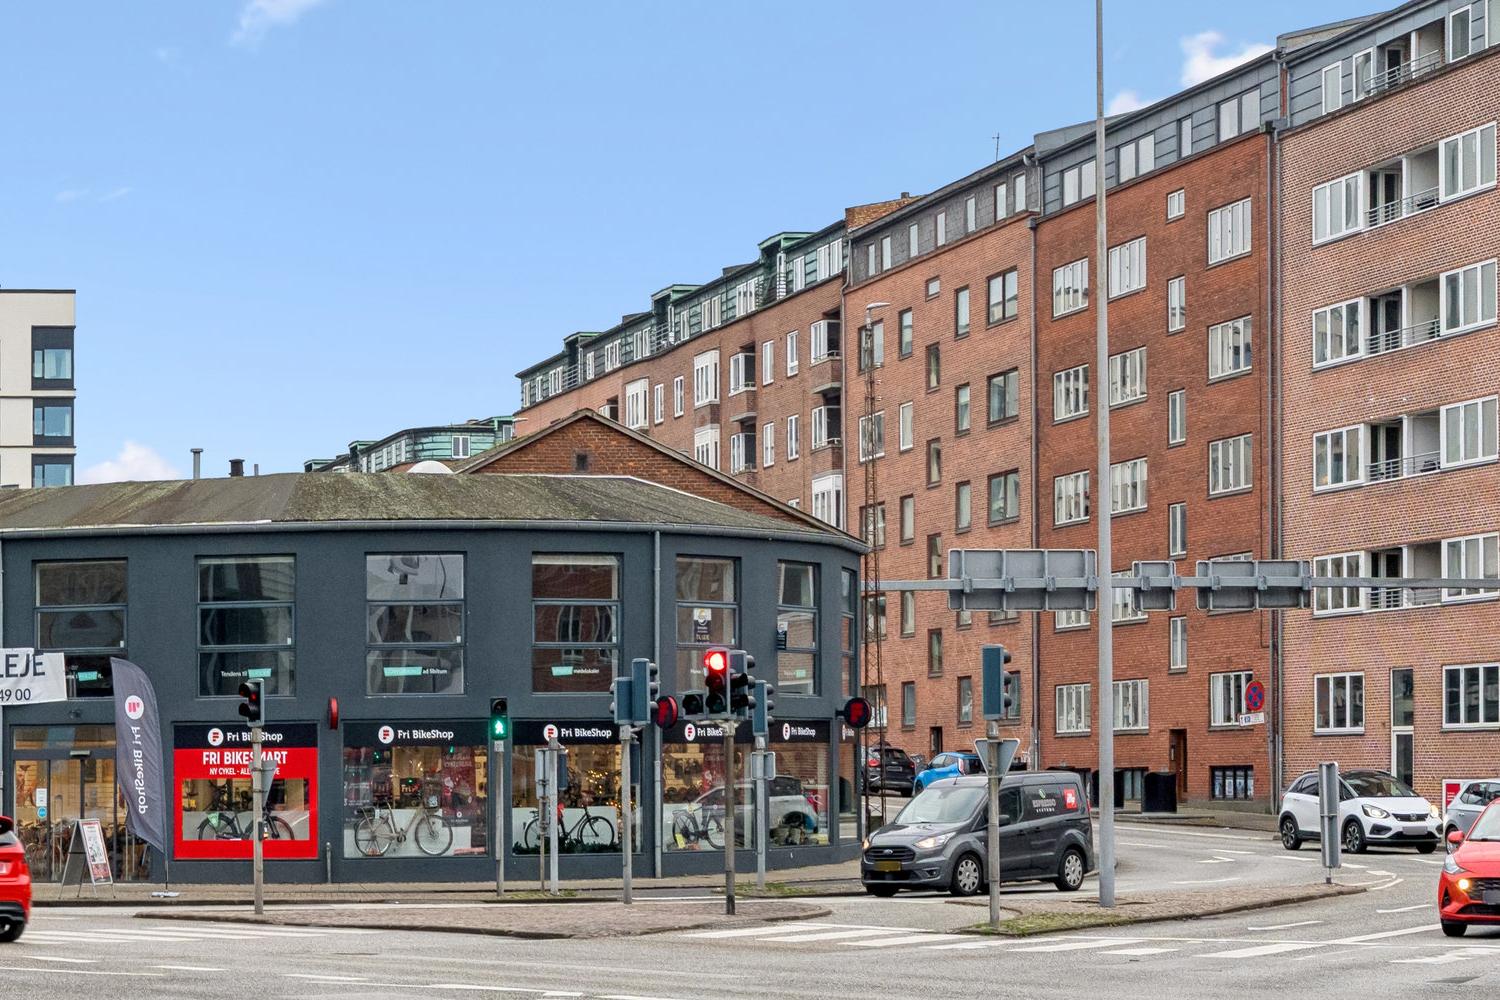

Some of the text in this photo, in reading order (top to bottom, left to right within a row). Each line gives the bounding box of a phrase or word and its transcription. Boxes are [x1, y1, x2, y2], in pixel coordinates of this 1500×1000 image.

[15, 688, 31, 700] 00
[227, 732, 239, 741] Fri
[242, 732, 283, 742] BiShop
[398, 730, 410, 739] Fri
[413, 729, 454, 740] BikeShop
[561, 728, 572, 737] Fri
[574, 728, 612, 738] BikeShop
[697, 728, 706, 736] Fri
[203, 752, 220, 764] FRI
